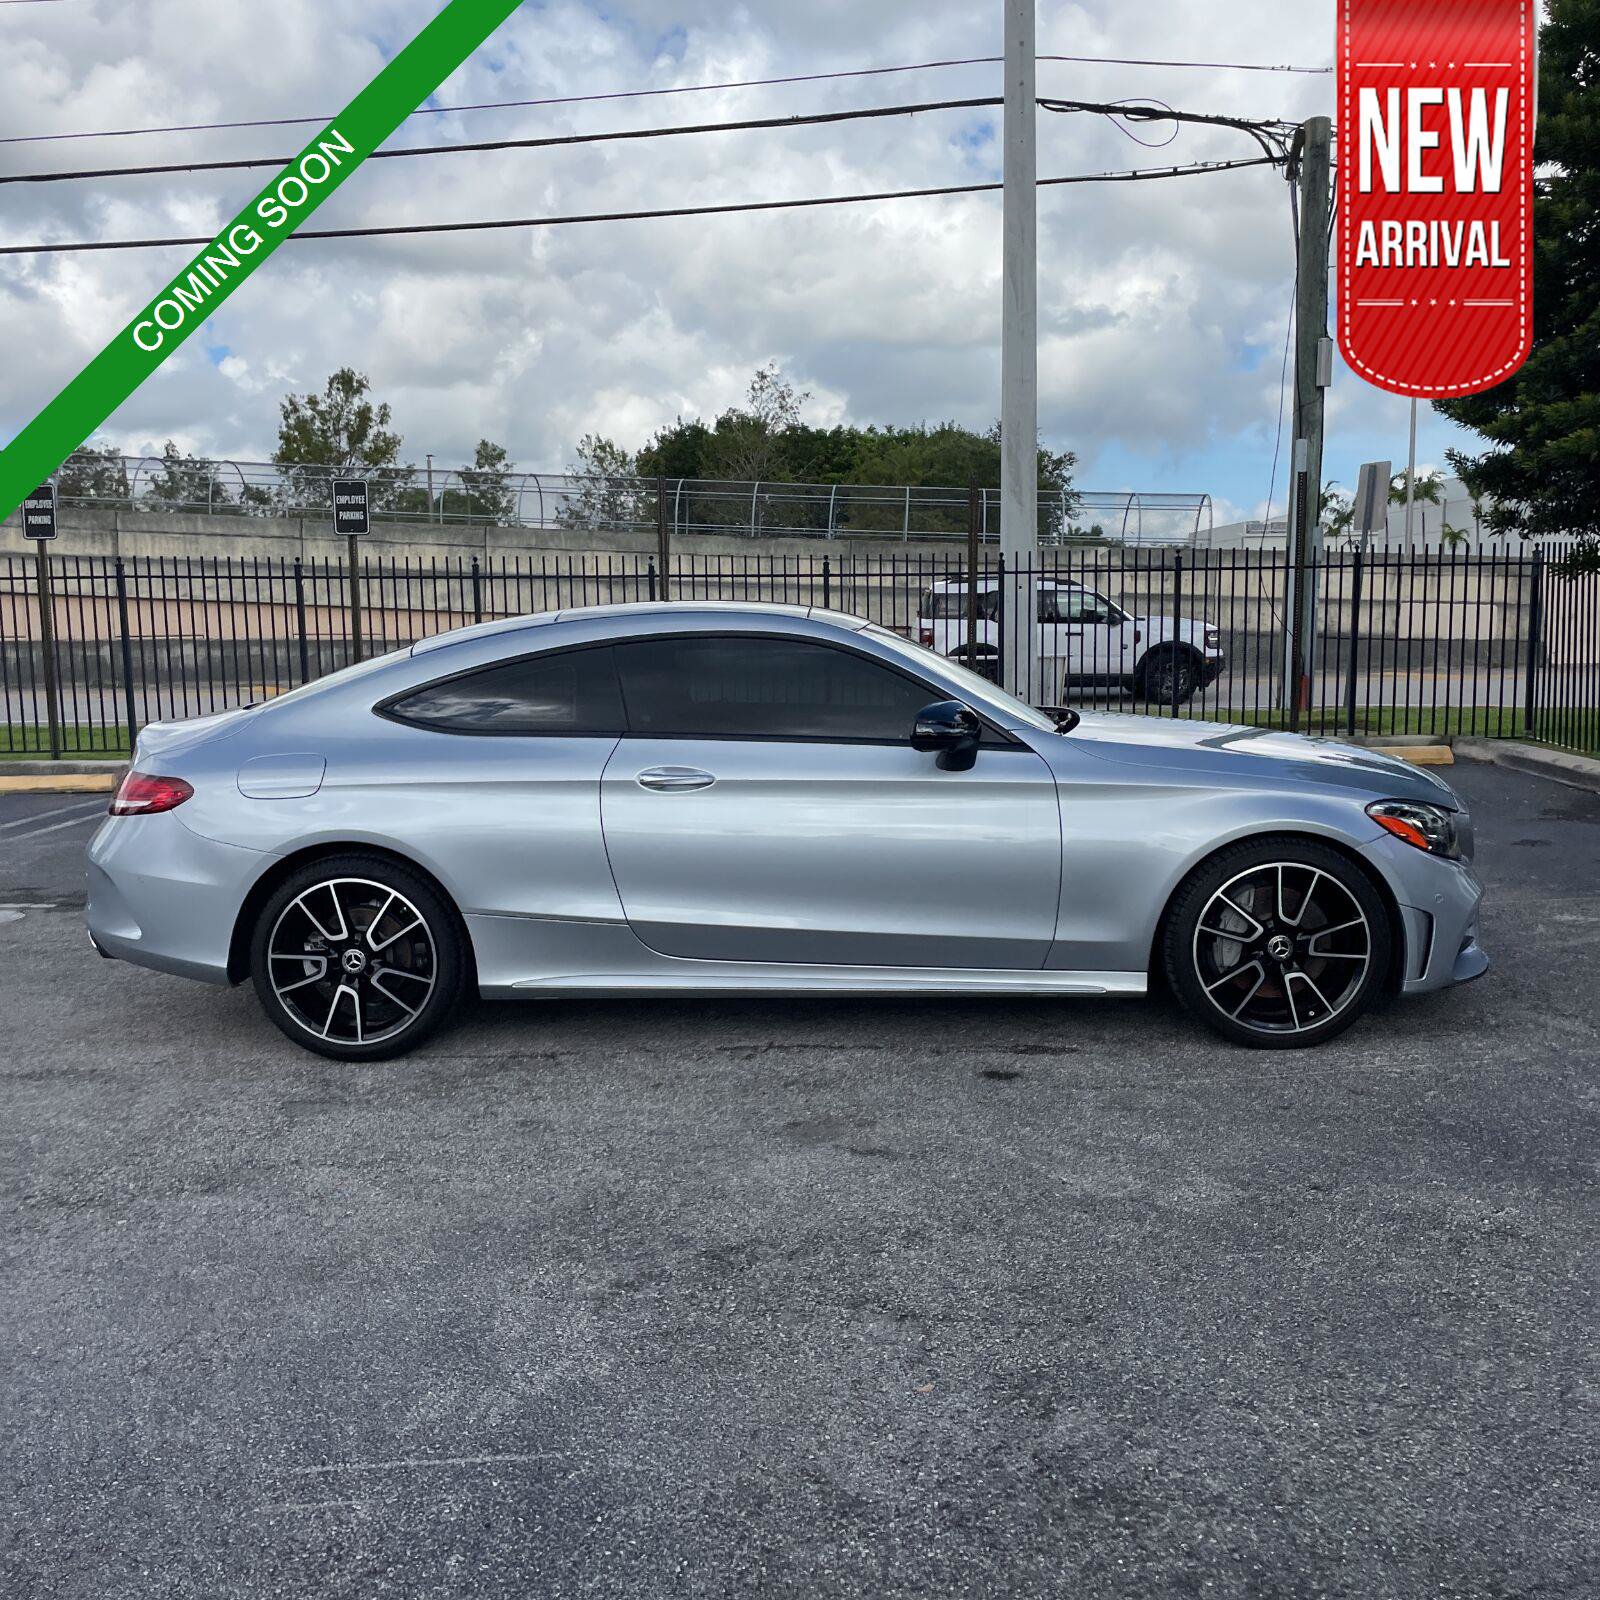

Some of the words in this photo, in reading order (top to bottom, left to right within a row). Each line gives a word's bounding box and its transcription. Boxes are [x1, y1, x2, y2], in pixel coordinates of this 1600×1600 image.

[336, 495, 365, 504] EMPLOYEE
[339, 511, 364, 520] PARKING
[28, 516, 51, 525] PARKING
